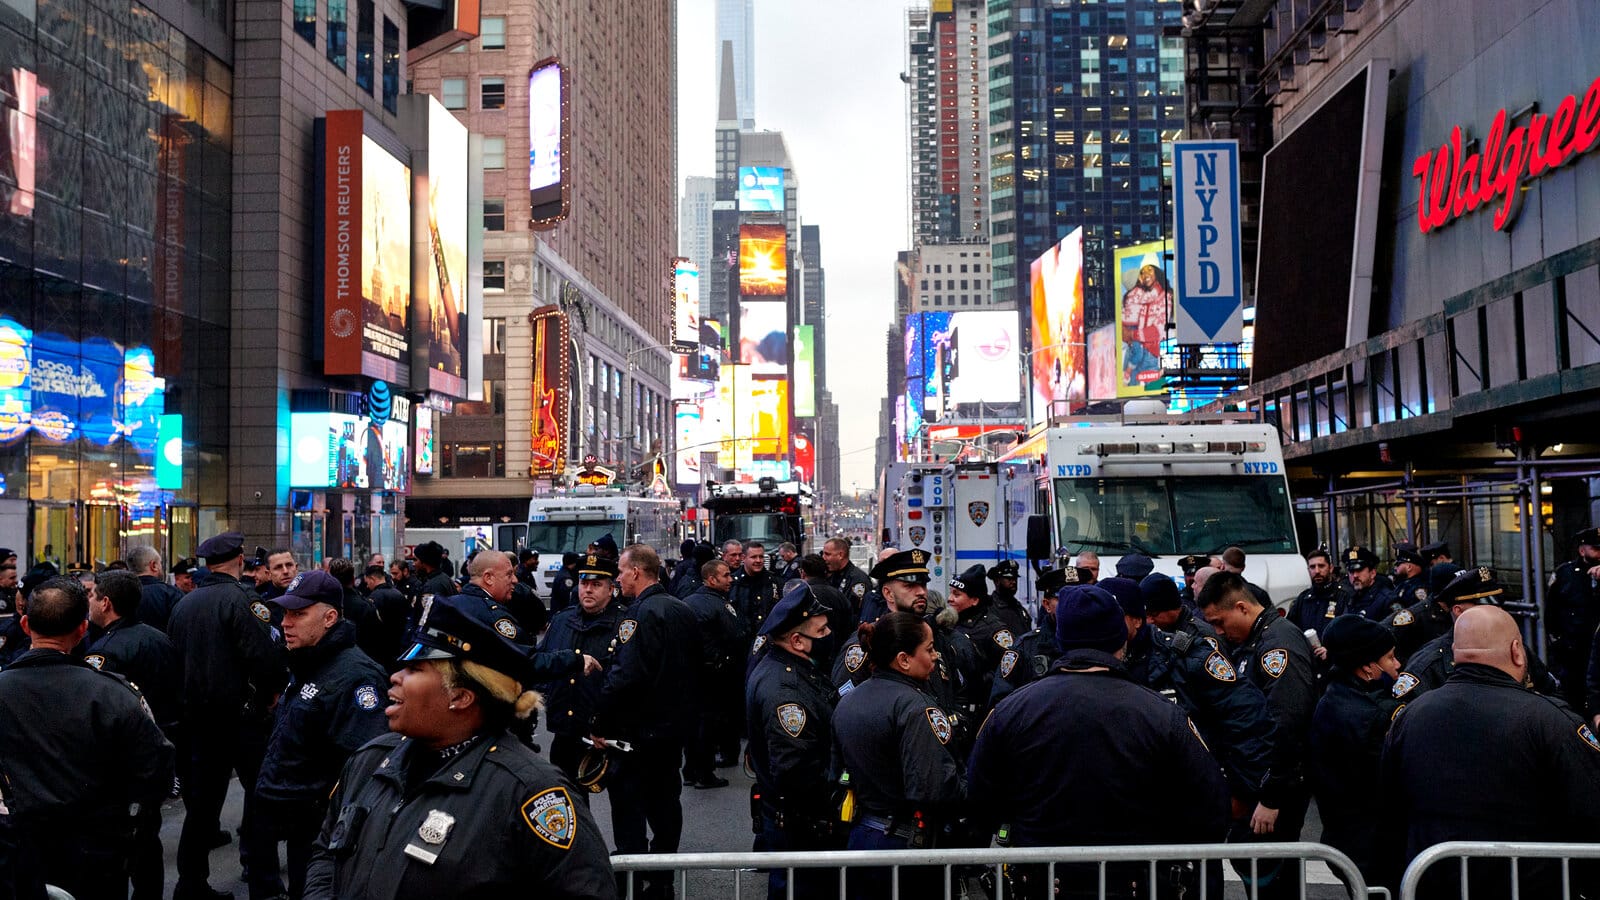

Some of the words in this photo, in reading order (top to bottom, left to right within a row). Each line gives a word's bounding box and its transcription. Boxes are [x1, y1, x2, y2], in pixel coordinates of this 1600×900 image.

[338, 146, 350, 215] REUTERS
[1194, 153, 1220, 294] NYPD
[337, 221, 350, 299] THOMSON
[1058, 464, 1092, 476] NYPD
[1243, 462, 1278, 474] NYPD
[933, 476, 942, 505] SOD
[529, 796, 567, 820] DEPARTMENT
[533, 792, 557, 807] POLICE
[535, 825, 550, 837] CITY
